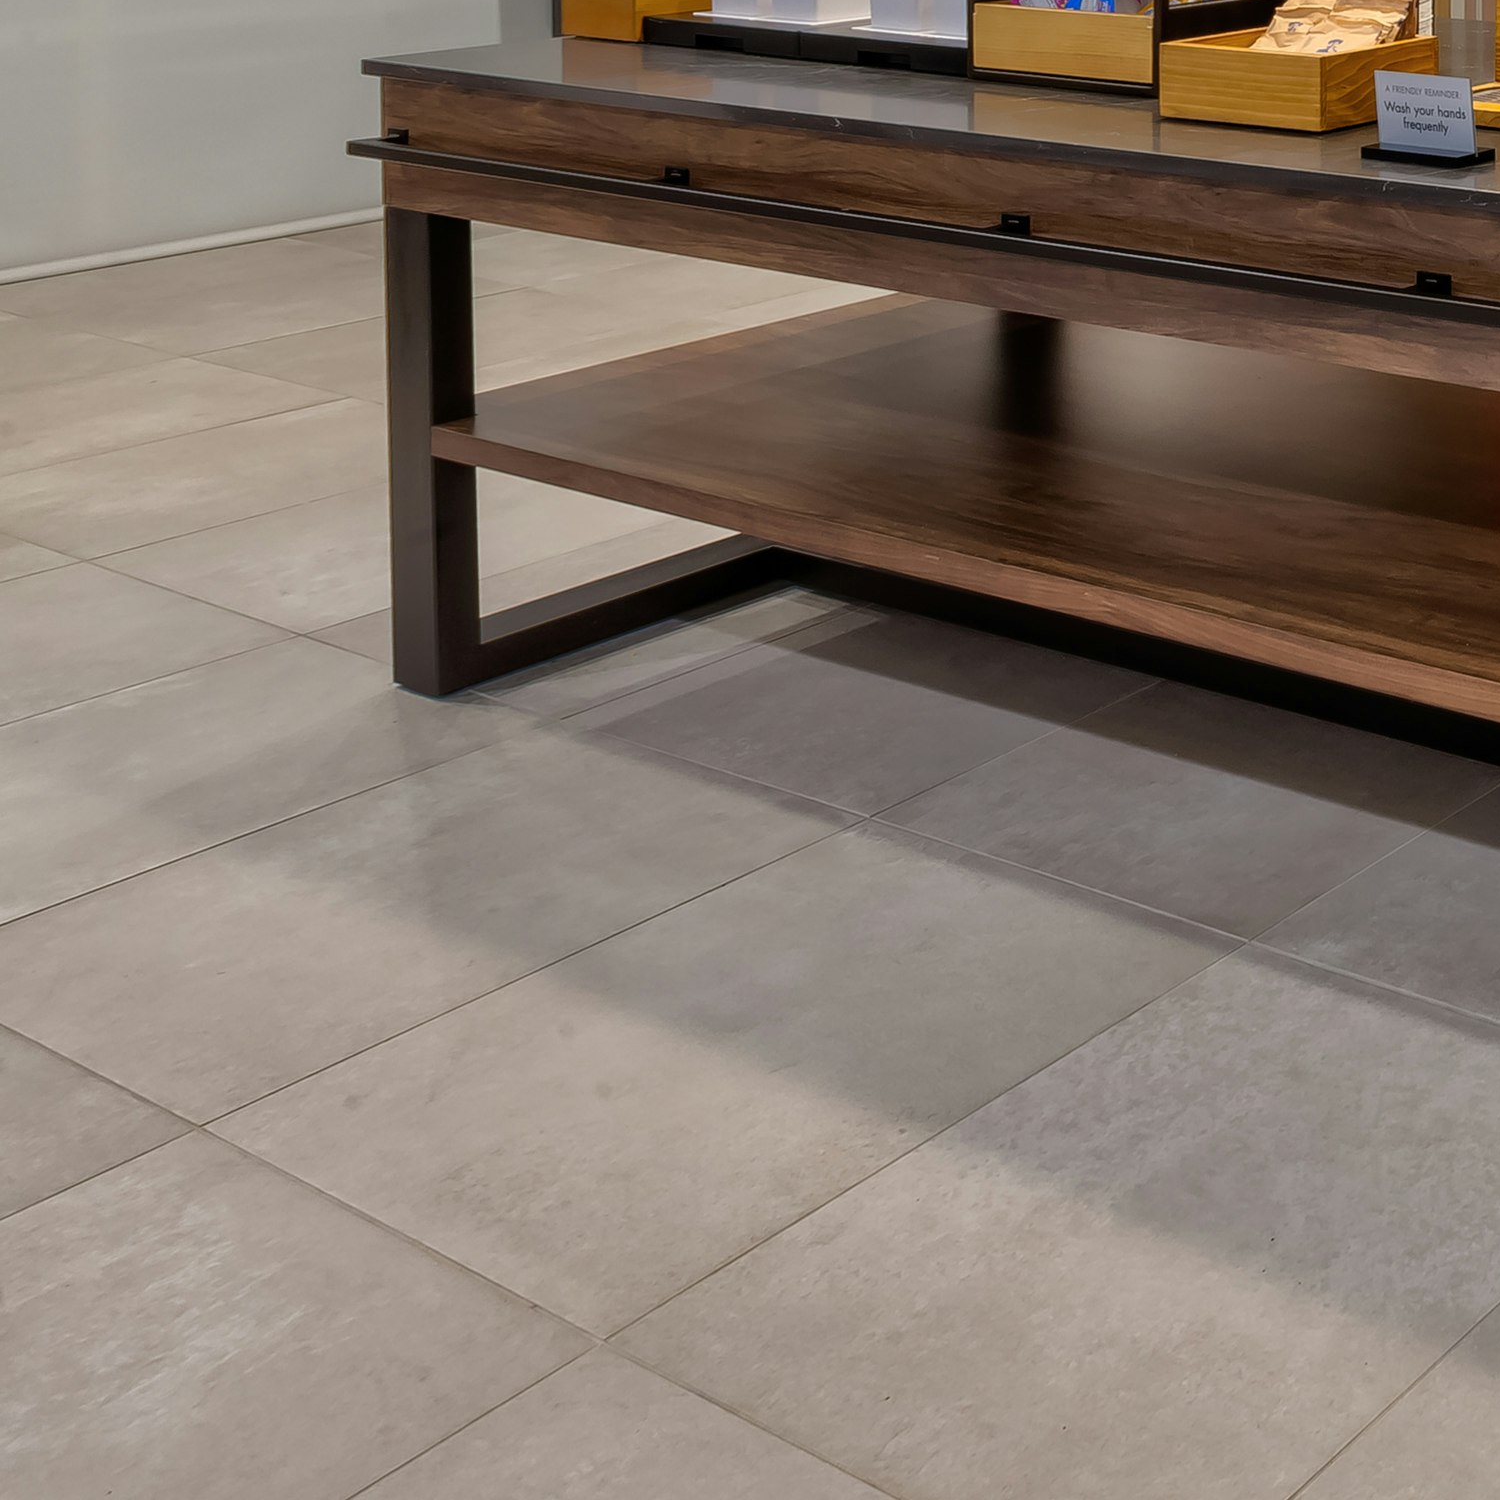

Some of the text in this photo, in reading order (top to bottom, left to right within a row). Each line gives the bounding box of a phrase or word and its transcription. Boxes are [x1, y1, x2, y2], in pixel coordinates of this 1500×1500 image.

[1385, 85, 1391, 93] A
[1392, 85, 1423, 97] FRIENDLY
[1384, 101, 1467, 120] Wash your hands
[1403, 117, 1449, 136] frequently
